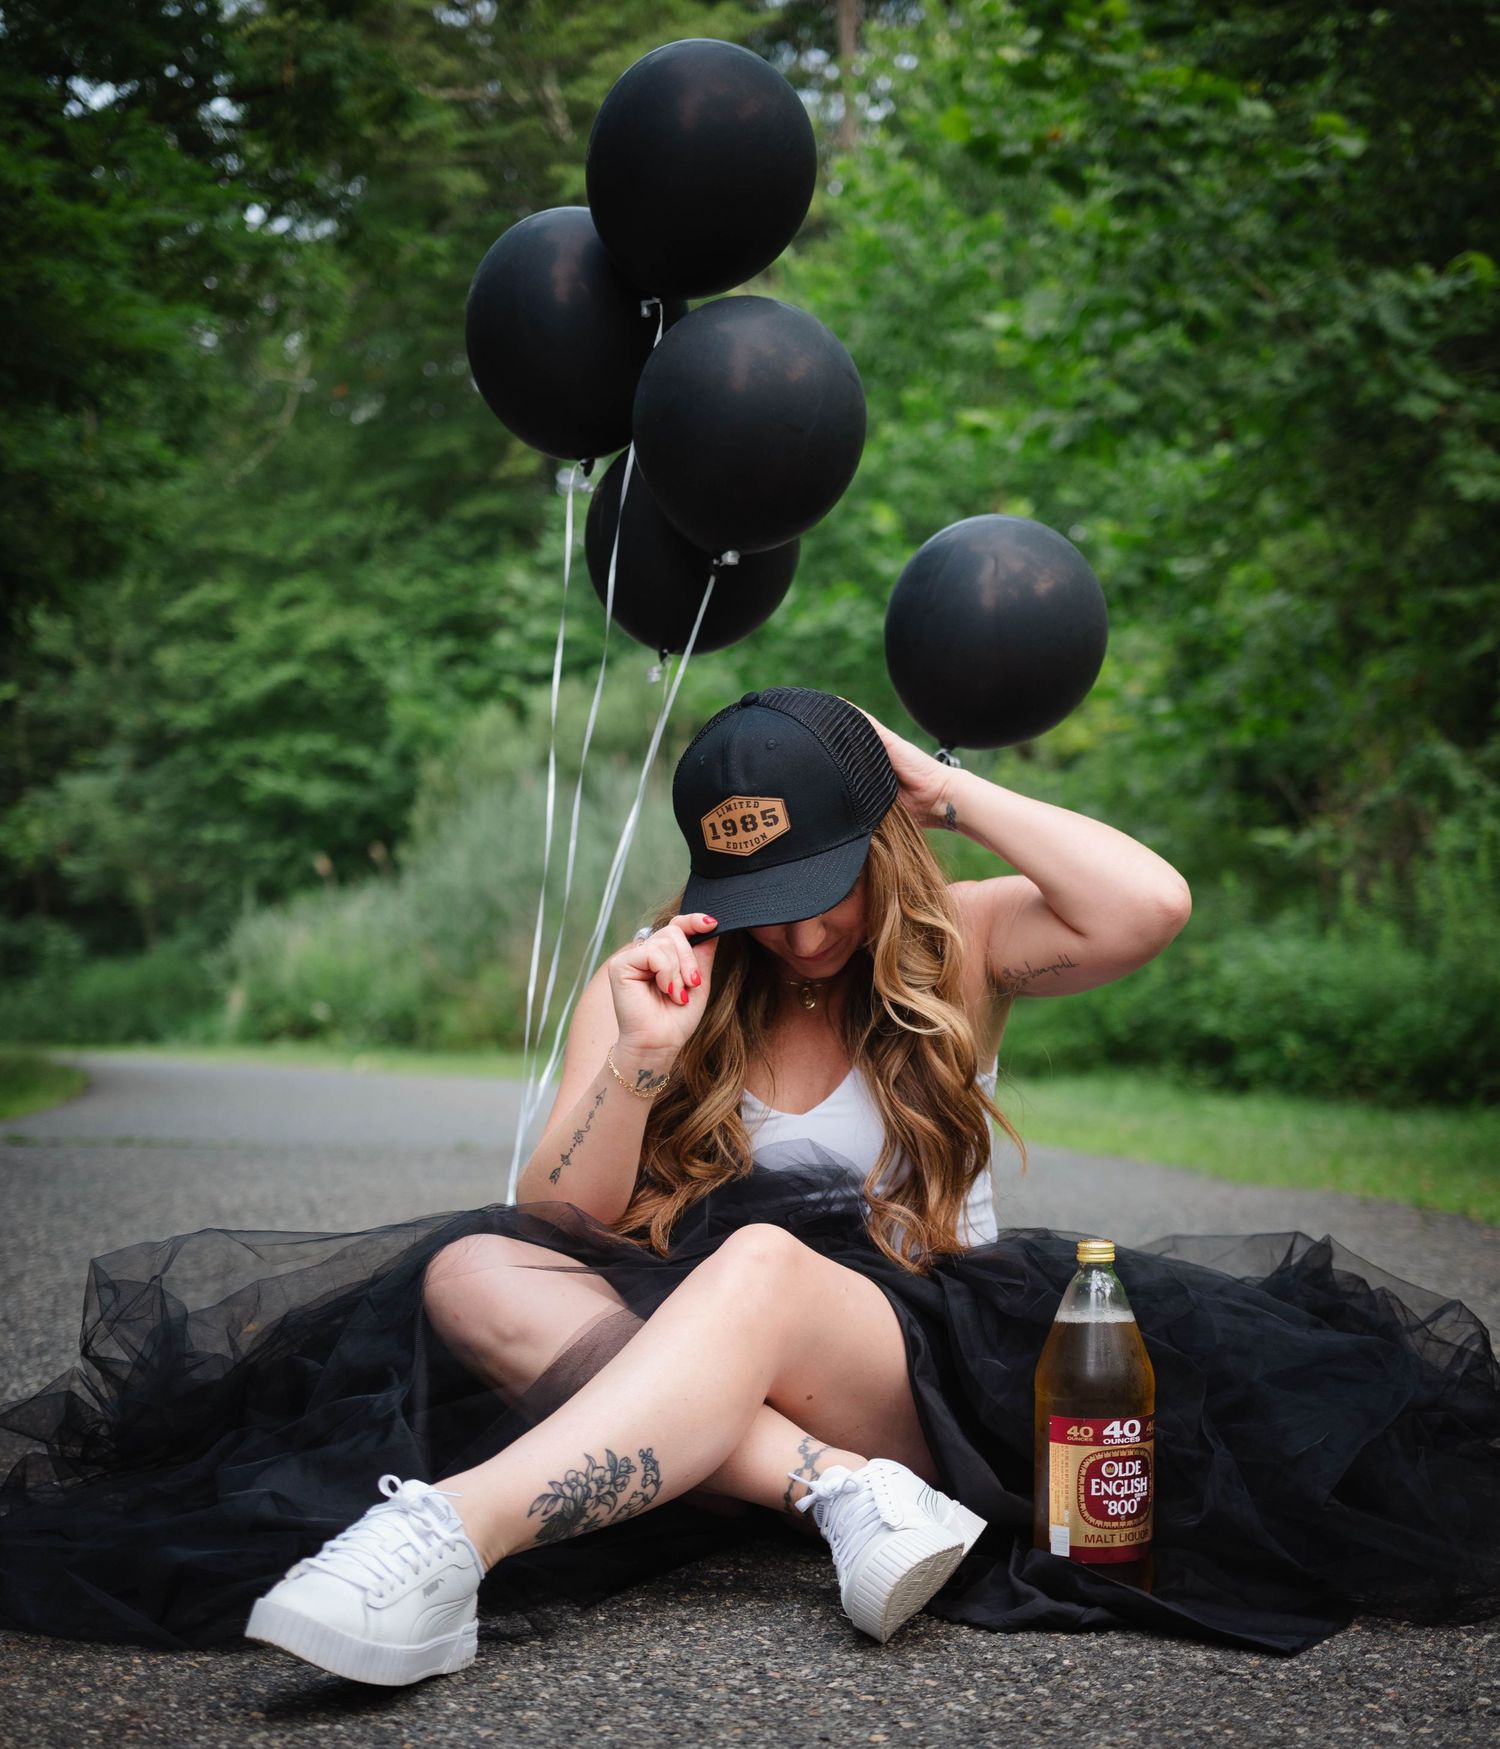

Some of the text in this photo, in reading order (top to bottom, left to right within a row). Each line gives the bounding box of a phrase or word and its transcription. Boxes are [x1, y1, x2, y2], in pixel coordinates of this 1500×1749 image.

[716, 800, 760, 818] LIMITED
[708, 807, 780, 841] 1985
[726, 832, 768, 850] EDITION
[1066, 1425, 1094, 1438] 40
[1102, 1419, 1141, 1438] 40
[1102, 1436, 1141, 1445] OUNCES
[1101, 1460, 1142, 1478] OLDE
[1091, 1476, 1148, 1498] ENGLISH
[1084, 1534, 1116, 1544] MALT
